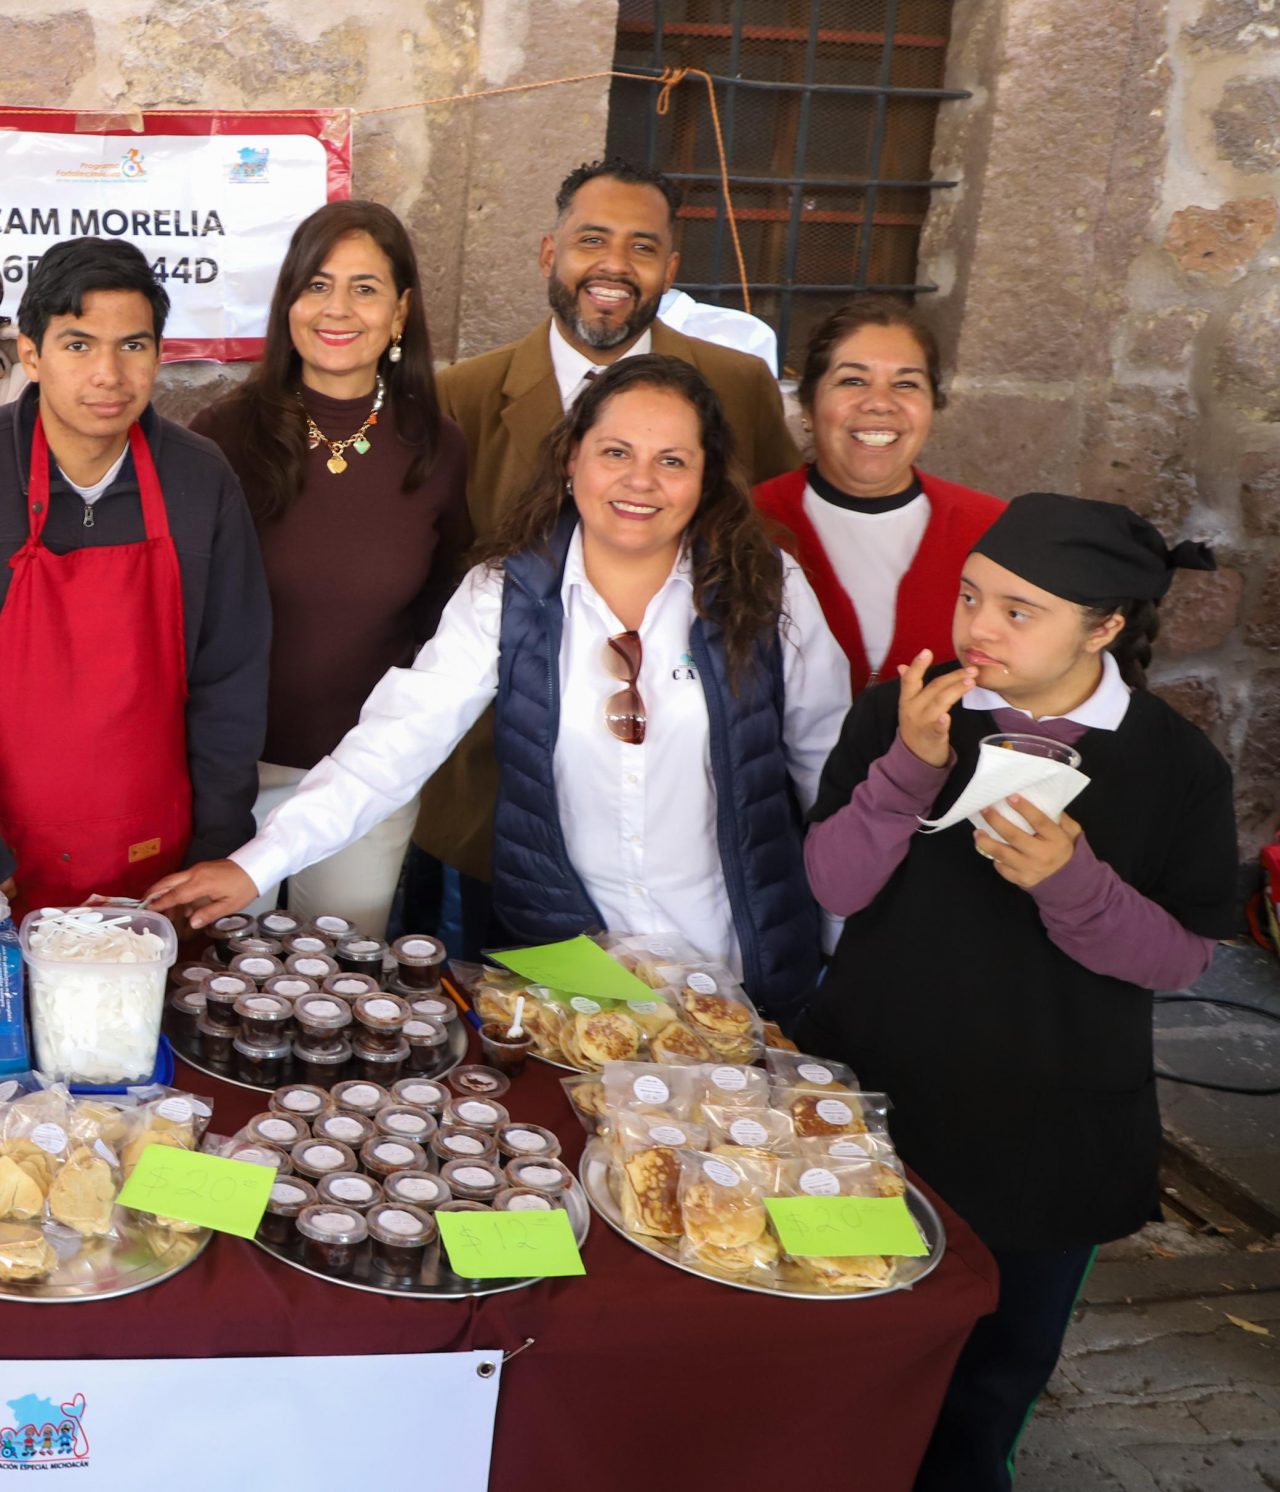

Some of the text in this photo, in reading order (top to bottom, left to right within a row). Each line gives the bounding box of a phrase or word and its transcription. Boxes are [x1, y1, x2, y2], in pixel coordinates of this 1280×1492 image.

[71, 208, 226, 237] MORELIA
[20, 1462, 49, 1470] ESPECIAL
[50, 1461, 89, 1470] MICHOACÁN
